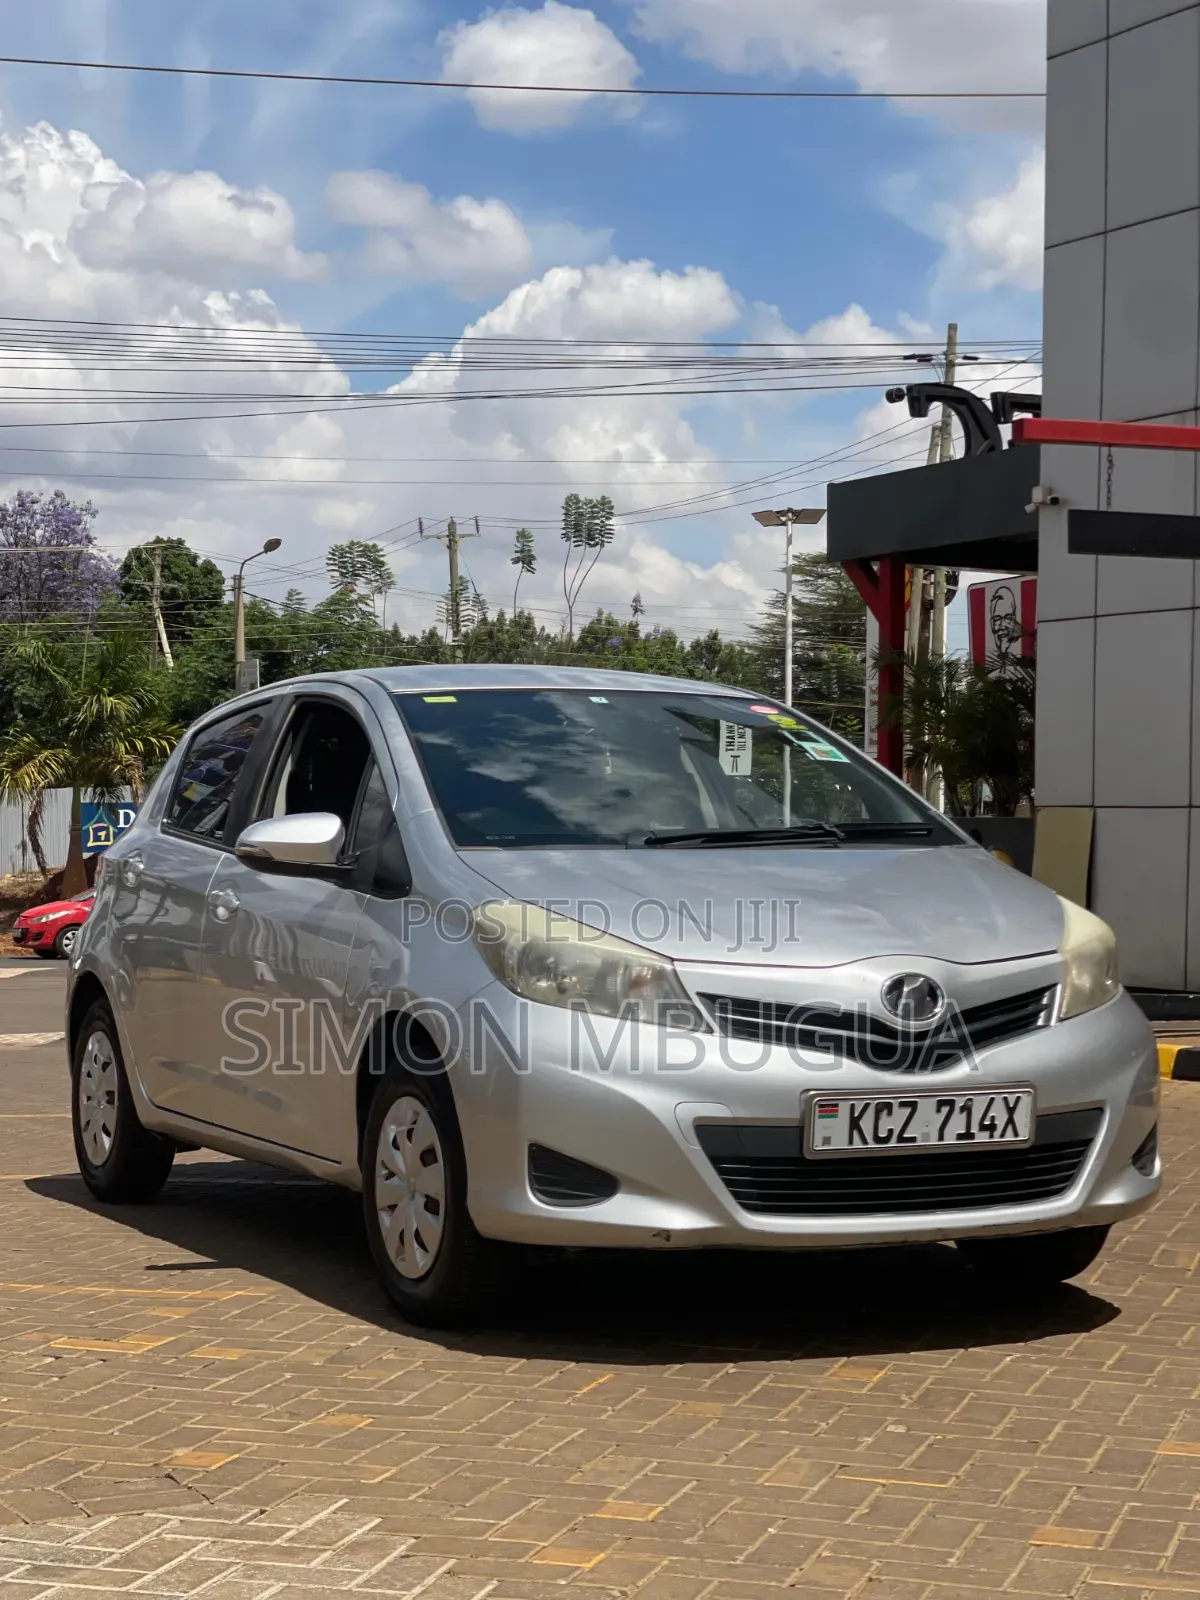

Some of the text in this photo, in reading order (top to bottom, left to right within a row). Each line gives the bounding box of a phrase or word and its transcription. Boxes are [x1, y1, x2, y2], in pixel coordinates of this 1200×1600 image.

[725, 724, 735, 752] THANK
[737, 725, 747, 739] NEX
[847, 1099, 920, 1147] KCZ
[935, 1095, 1022, 1143] 714X
